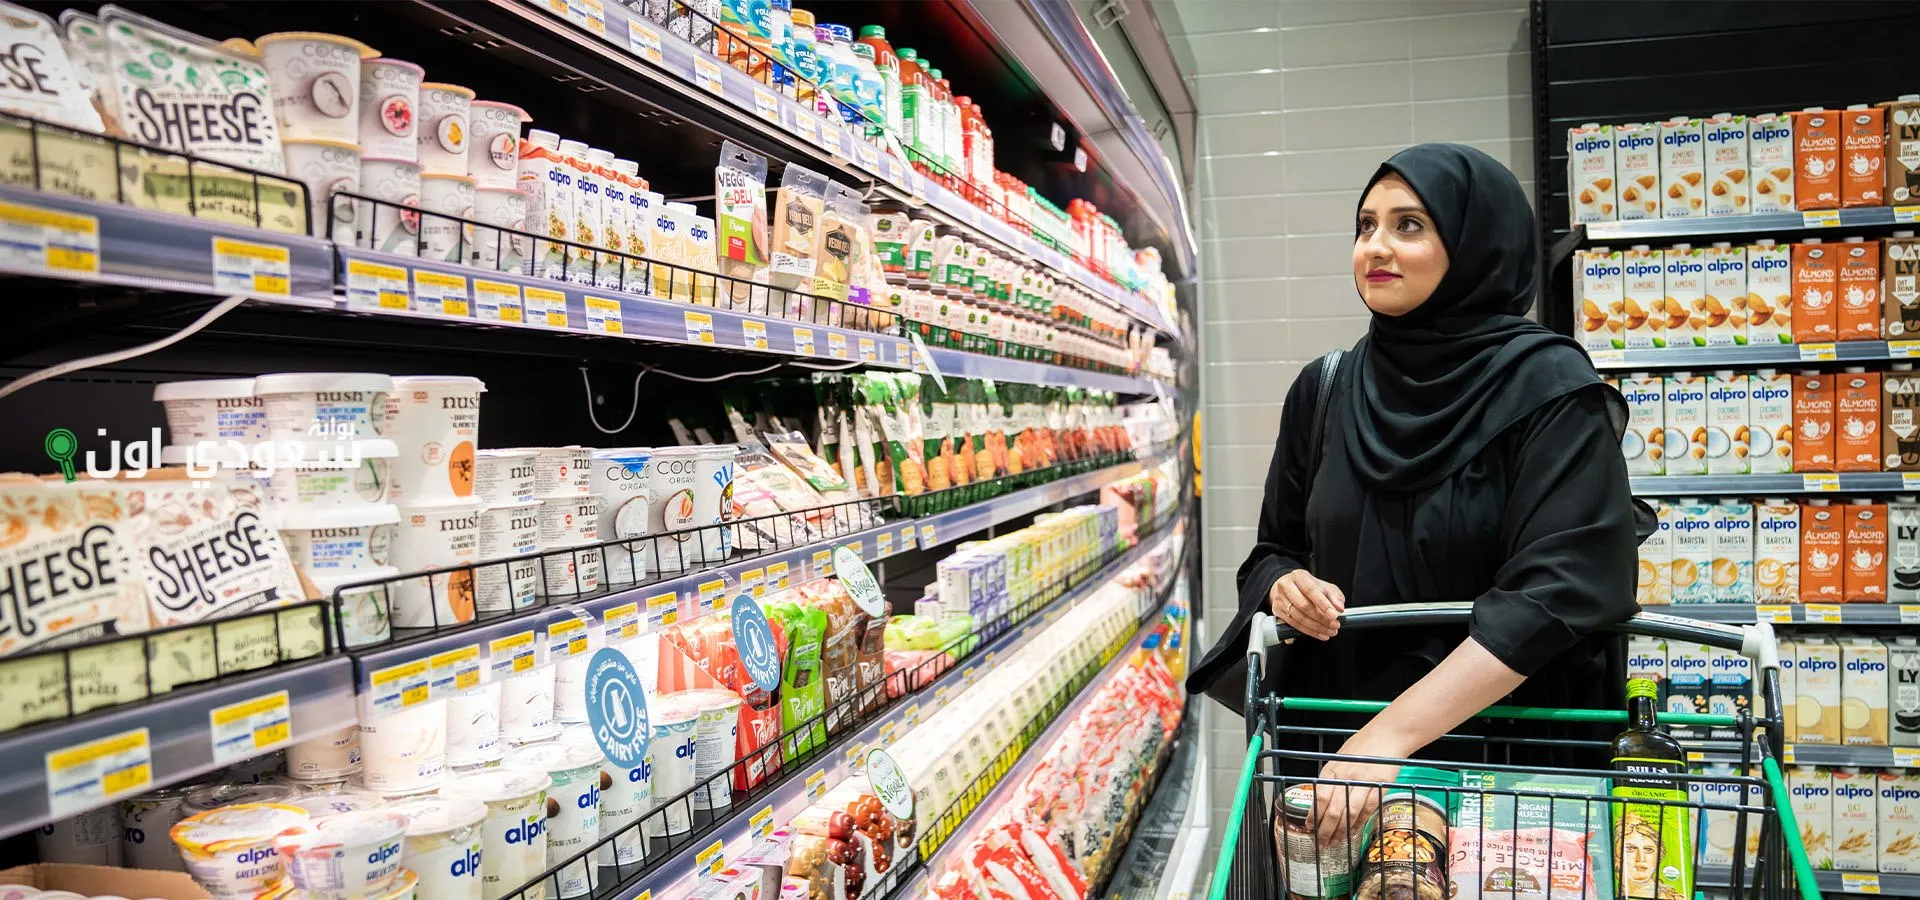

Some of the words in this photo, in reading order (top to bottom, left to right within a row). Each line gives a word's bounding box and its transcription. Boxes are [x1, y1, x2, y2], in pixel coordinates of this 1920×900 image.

[135, 87, 262, 152] SHEESE
[1663, 130, 1702, 148] alpro
[1706, 127, 1745, 144] alpro
[1751, 125, 1791, 143] alpro
[1800, 138, 1836, 147] ALMOND
[1845, 135, 1881, 145] ALMOND
[1574, 138, 1611, 153] alpro
[1617, 135, 1655, 151] alpro
[549, 167, 571, 187] alpro
[577, 175, 599, 195] alpro
[605, 184, 624, 203] alpro
[629, 191, 649, 209] alpro
[656, 214, 675, 232] alpro
[690, 223, 708, 241] alpro
[1585, 262, 1621, 280] alpro
[1625, 262, 1662, 278] alpro
[1667, 259, 1704, 277] alpro
[1707, 258, 1744, 275] alpro
[1751, 255, 1788, 273] alpro
[1840, 267, 1877, 277] ALMOND
[1799, 268, 1834, 278] ALMOND
[1624, 389, 1661, 406] alpro
[1667, 387, 1704, 404] alpro
[1709, 386, 1747, 402] alpro
[1752, 385, 1789, 402] alpro
[1796, 400, 1831, 409] ALMOND
[1840, 398, 1877, 408] ALMOND
[510, 465, 535, 479] nus
[578, 504, 598, 516] nus
[510, 515, 537, 530] nus
[1674, 515, 1711, 533] alpro
[1713, 516, 1751, 533] alpro
[1760, 516, 1798, 533] alpro
[1680, 536, 1705, 545] BARISTA
[1719, 535, 1745, 544] BARISTA
[1766, 536, 1792, 545] BARISTA
[1804, 531, 1840, 540] ALMOND
[1848, 530, 1884, 540] ALMOND
[150, 512, 270, 604] SHEESE
[0, 525, 116, 636] HEESE
[745, 654, 771, 685] DAIRY
[767, 643, 777, 681] FREE
[1628, 654, 1664, 670] alpro
[1670, 654, 1707, 671] alpro
[1711, 654, 1749, 671] alpro
[1798, 656, 1837, 673] alpro
[1846, 657, 1886, 675] alpro
[598, 724, 634, 762] DAIRY
[631, 706, 647, 755] FREE
[675, 737, 697, 760] alp
[628, 761, 651, 785] alp
[577, 785, 600, 809] alp
[1631, 790, 1668, 799] ORGANIC
[1792, 783, 1830, 799] alpro
[1835, 784, 1873, 800] alpro
[1880, 785, 1920, 802] alpro
[1804, 803, 1816, 811] OAT
[1848, 804, 1861, 812] OAT
[450, 847, 482, 878] alp
